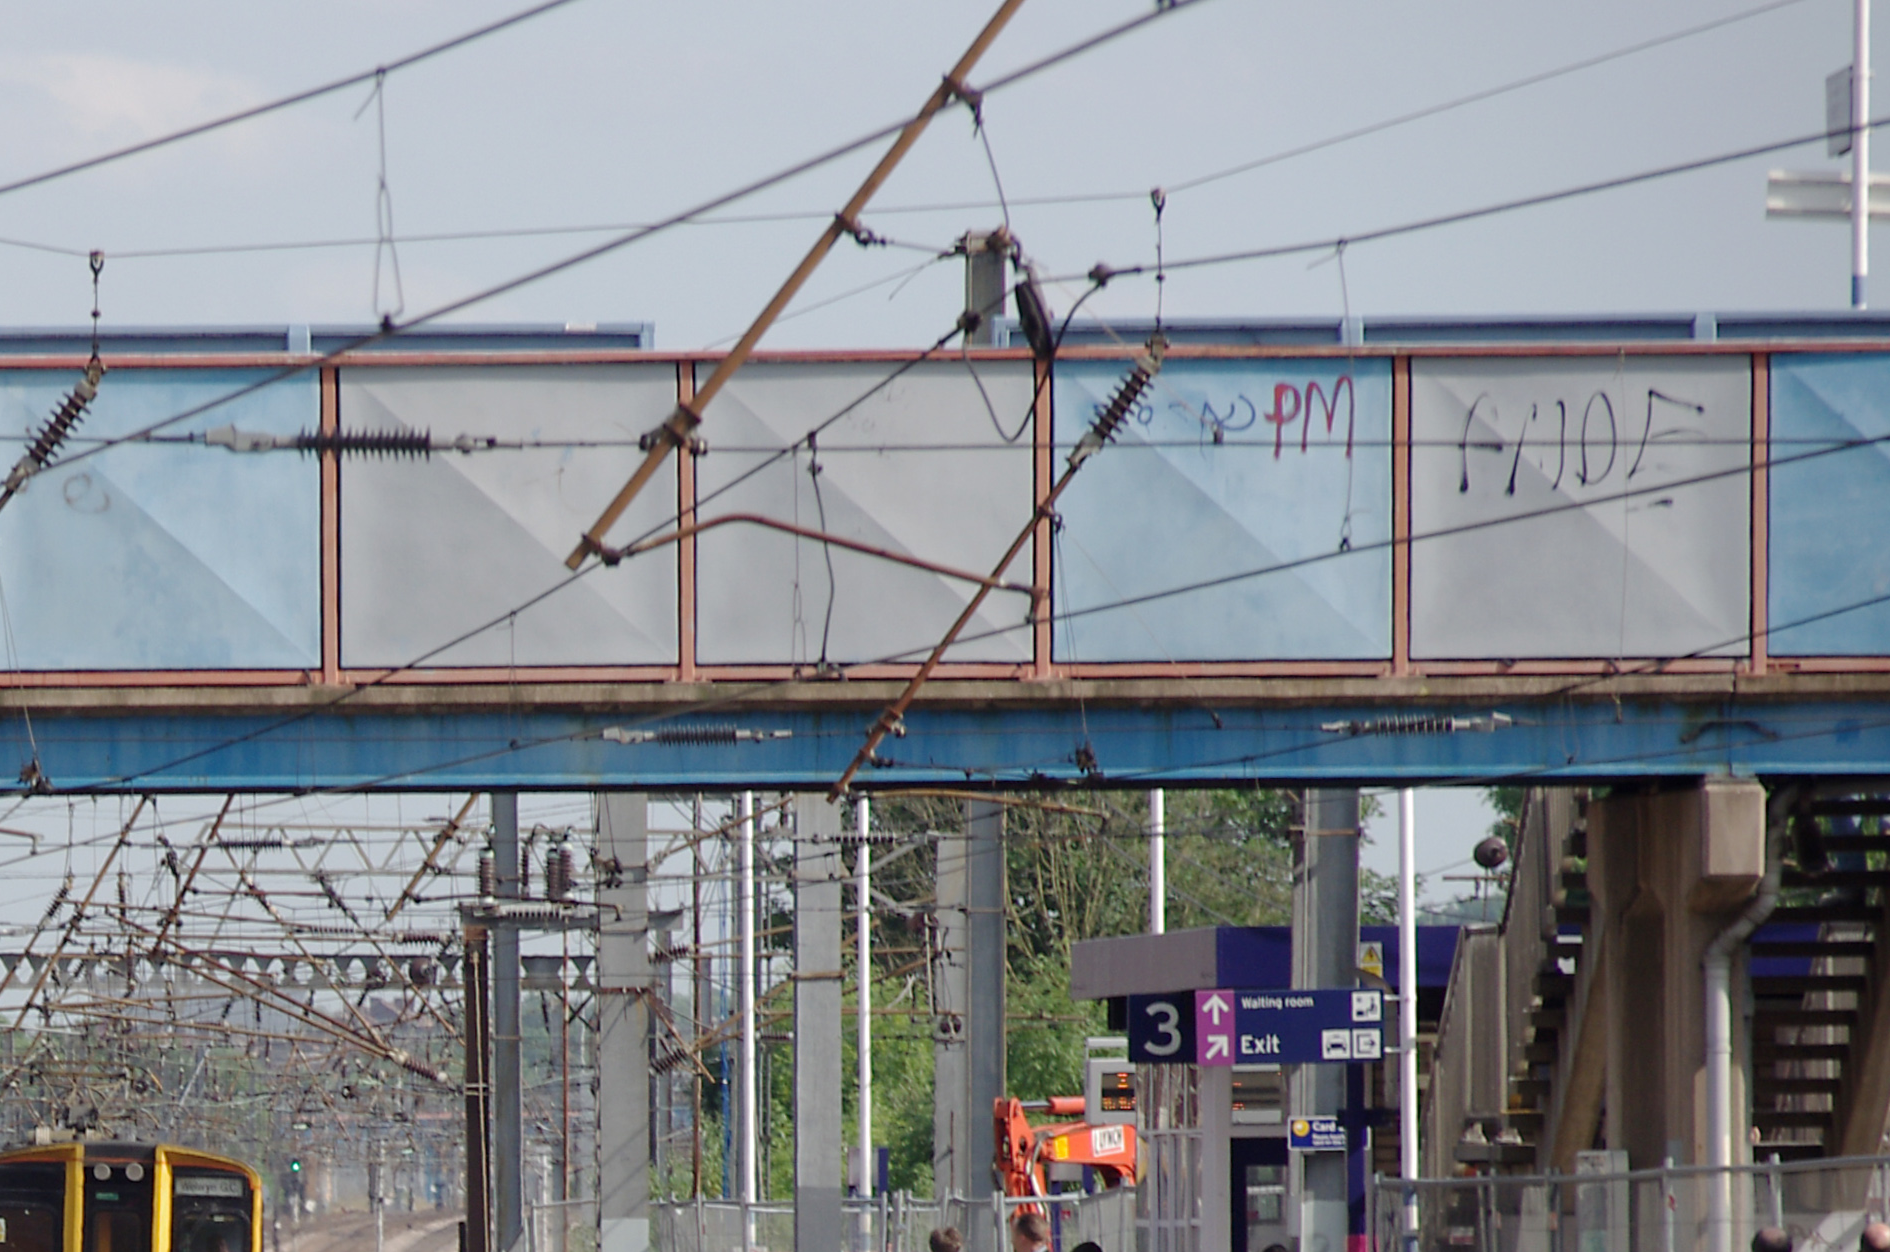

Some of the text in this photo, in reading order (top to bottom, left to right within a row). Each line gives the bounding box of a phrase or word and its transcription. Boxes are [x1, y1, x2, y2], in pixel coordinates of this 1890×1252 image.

[1241, 995, 1314, 1010] Waiting room
[1144, 1002, 1181, 1056] 3
[1241, 1034, 1280, 1054] Exit
